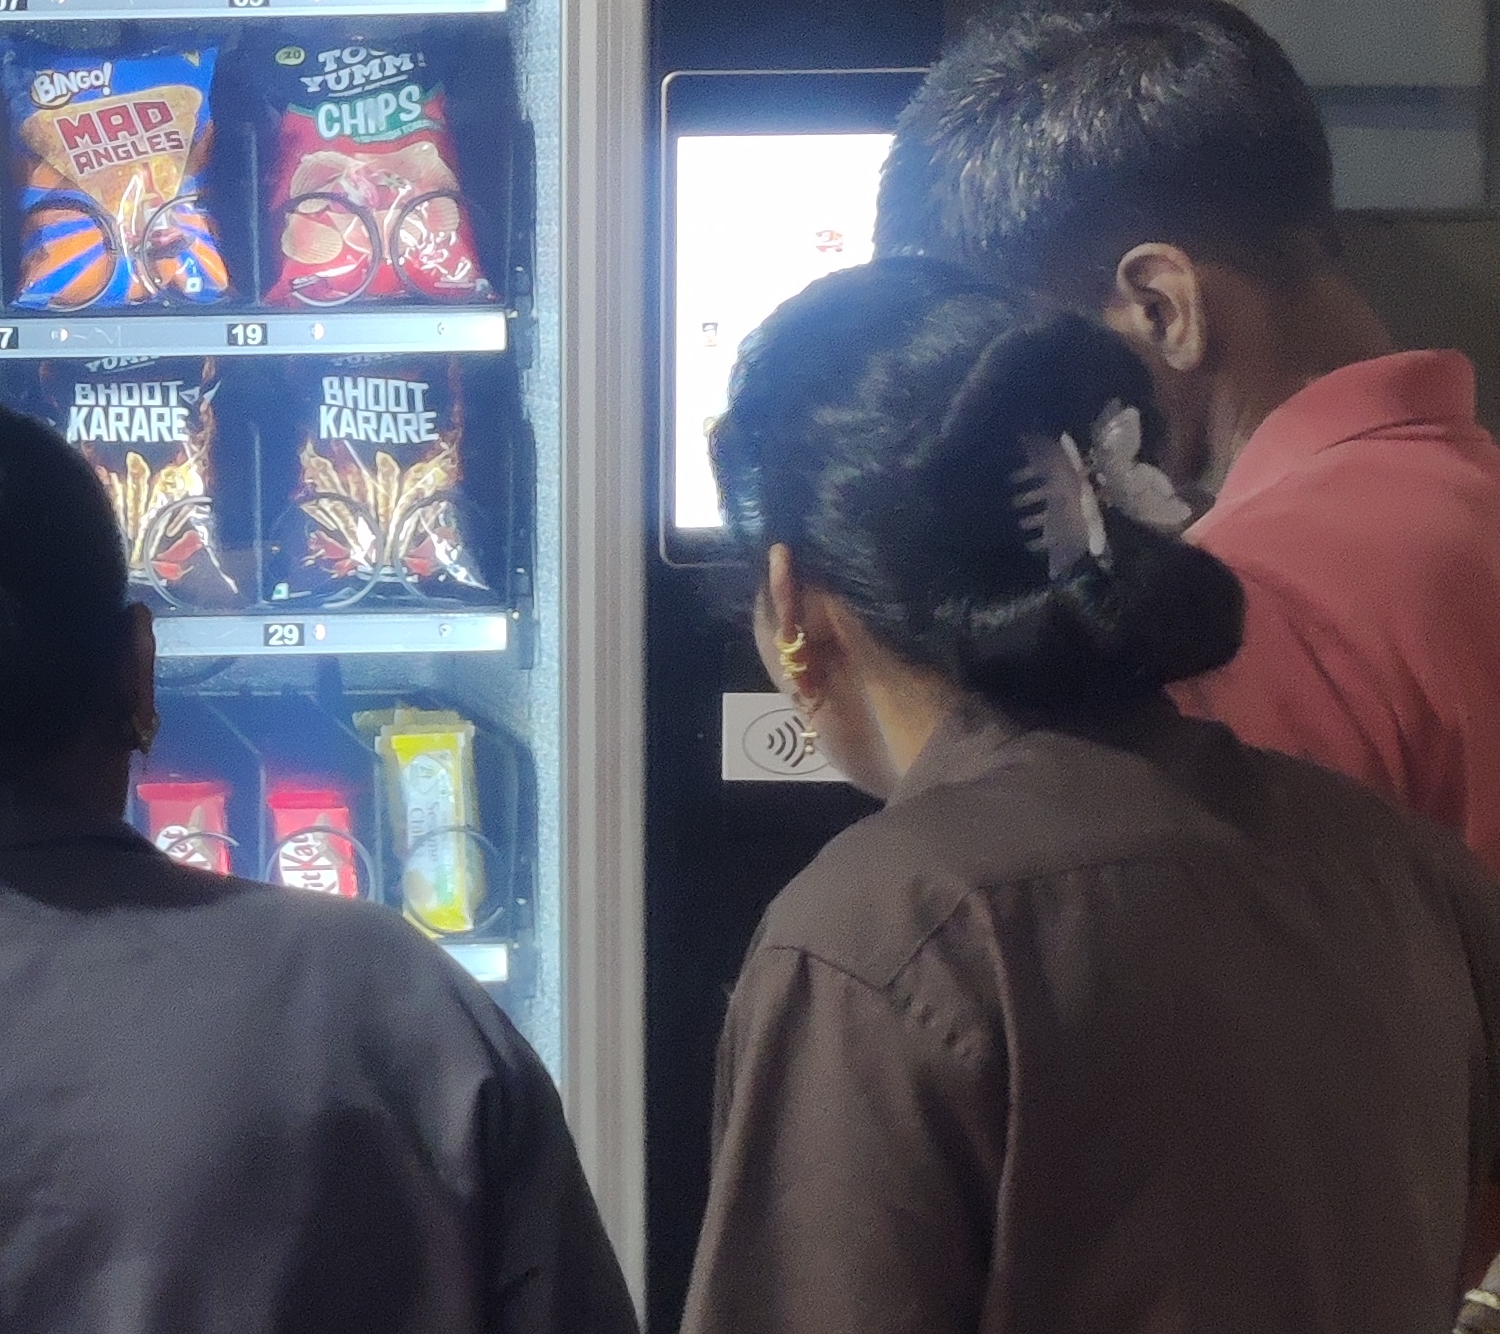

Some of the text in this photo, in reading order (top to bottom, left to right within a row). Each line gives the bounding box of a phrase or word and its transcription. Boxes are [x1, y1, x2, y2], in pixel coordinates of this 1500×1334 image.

[318, 46, 386, 72] TO
[56, 101, 174, 150] MAD
[318, 85, 421, 138] CHIPS
[73, 131, 184, 174] ANGLES
[231, 323, 262, 345] 19
[75, 380, 184, 407] BHOOT
[322, 376, 429, 413] BHOOT
[67, 406, 190, 443] KARARE
[320, 405, 439, 444] KARARE
[268, 625, 299, 645] 29
